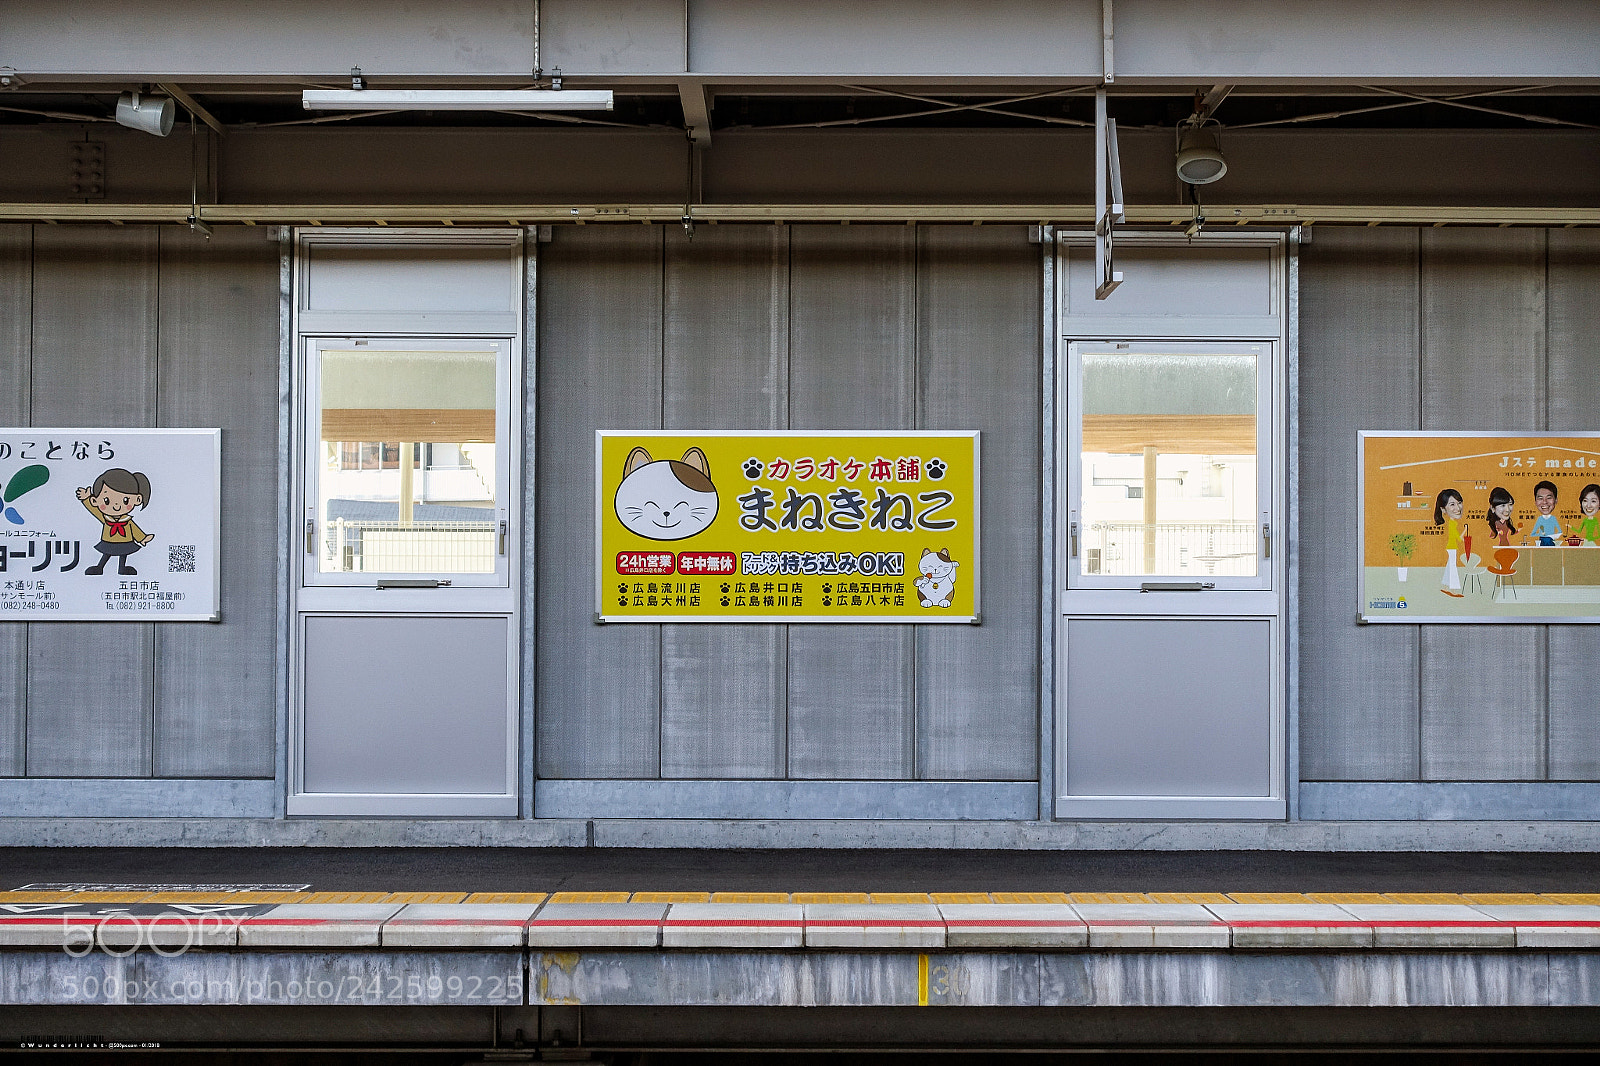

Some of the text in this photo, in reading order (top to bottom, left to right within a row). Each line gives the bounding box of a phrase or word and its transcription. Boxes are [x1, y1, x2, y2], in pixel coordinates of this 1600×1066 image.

[0, 441, 115, 460] のことなら
[1499, 456, 1597, 468] Jステ made
[768, 457, 921, 482] カラオケ本舗
[737, 486, 957, 532] まねきねこ
[619, 554, 672, 568] 24h営業
[680, 555, 733, 572] 年中無休
[4, 580, 45, 591] 本通り店
[119, 581, 160, 591] 五日市店
[632, 582, 701, 594] 広島流川店
[734, 582, 803, 594] 広島井口店
[836, 582, 905, 594] 広島五日市店
[632, 595, 701, 607] 広島大州店
[734, 595, 803, 607] 広島横川店
[836, 595, 905, 607] 広島八木店
